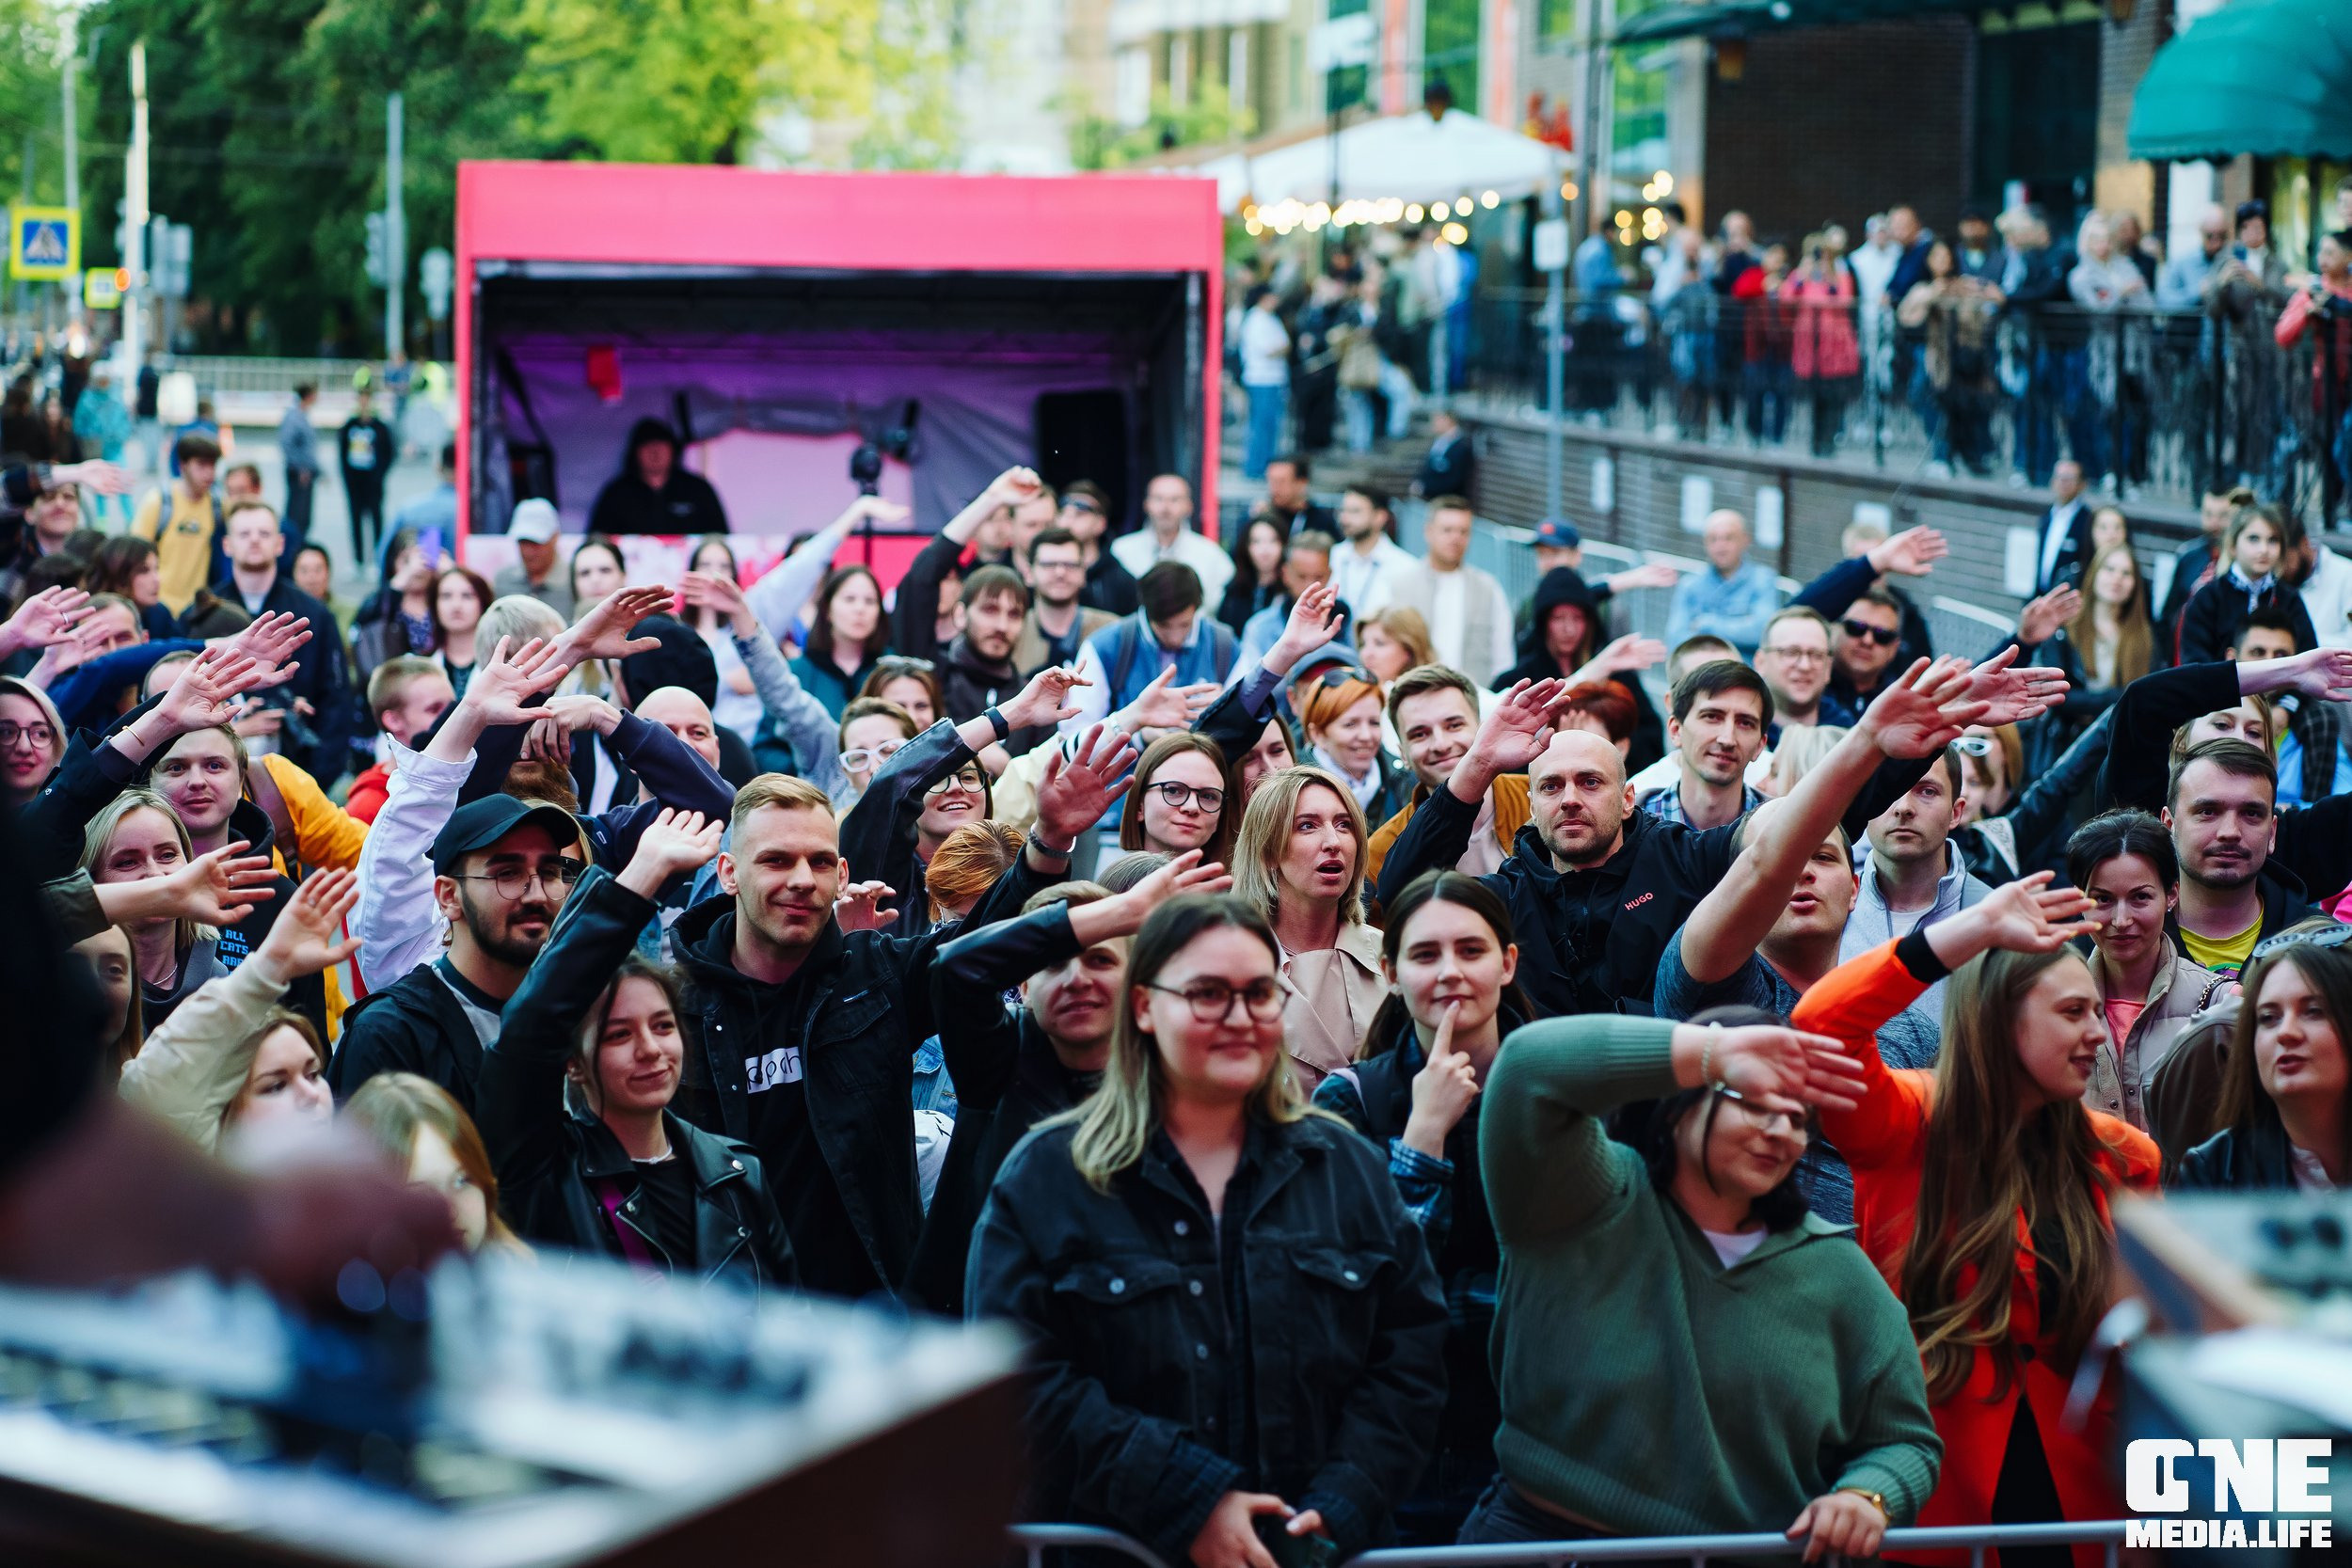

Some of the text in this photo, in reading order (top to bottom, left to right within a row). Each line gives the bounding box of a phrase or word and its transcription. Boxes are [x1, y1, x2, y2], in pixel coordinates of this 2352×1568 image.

[1625, 893, 1654, 911] HUGO
[226, 928, 246, 942] ALL
[220, 941, 248, 955] CATS
